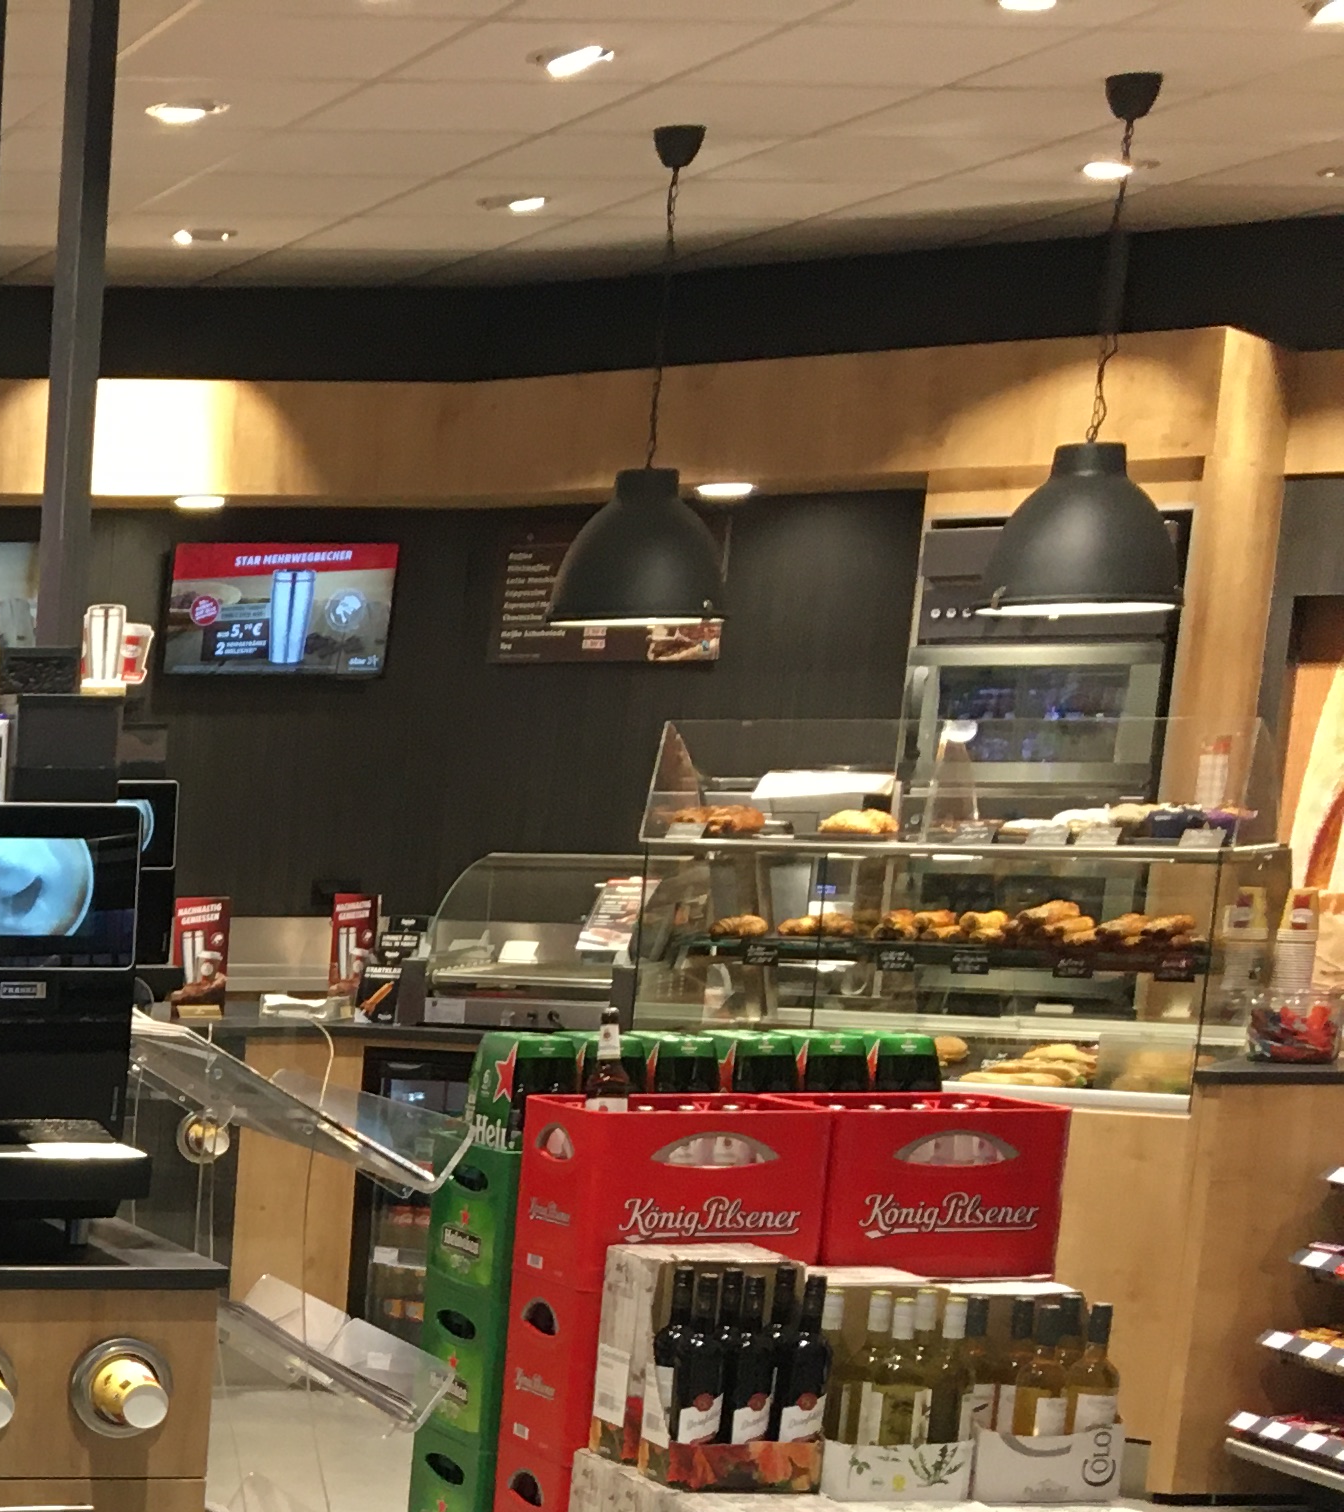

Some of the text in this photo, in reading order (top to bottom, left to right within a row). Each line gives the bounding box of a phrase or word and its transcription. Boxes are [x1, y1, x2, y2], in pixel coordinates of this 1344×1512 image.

[235, 550, 353, 567] STAR MEHRWEGBECHER
[178, 903, 223, 916] NACHHALTIG
[181, 912, 220, 926] GENIESSEN
[618, 1196, 801, 1234] König Pilsener
[859, 1191, 1040, 1231] König Pilsener
